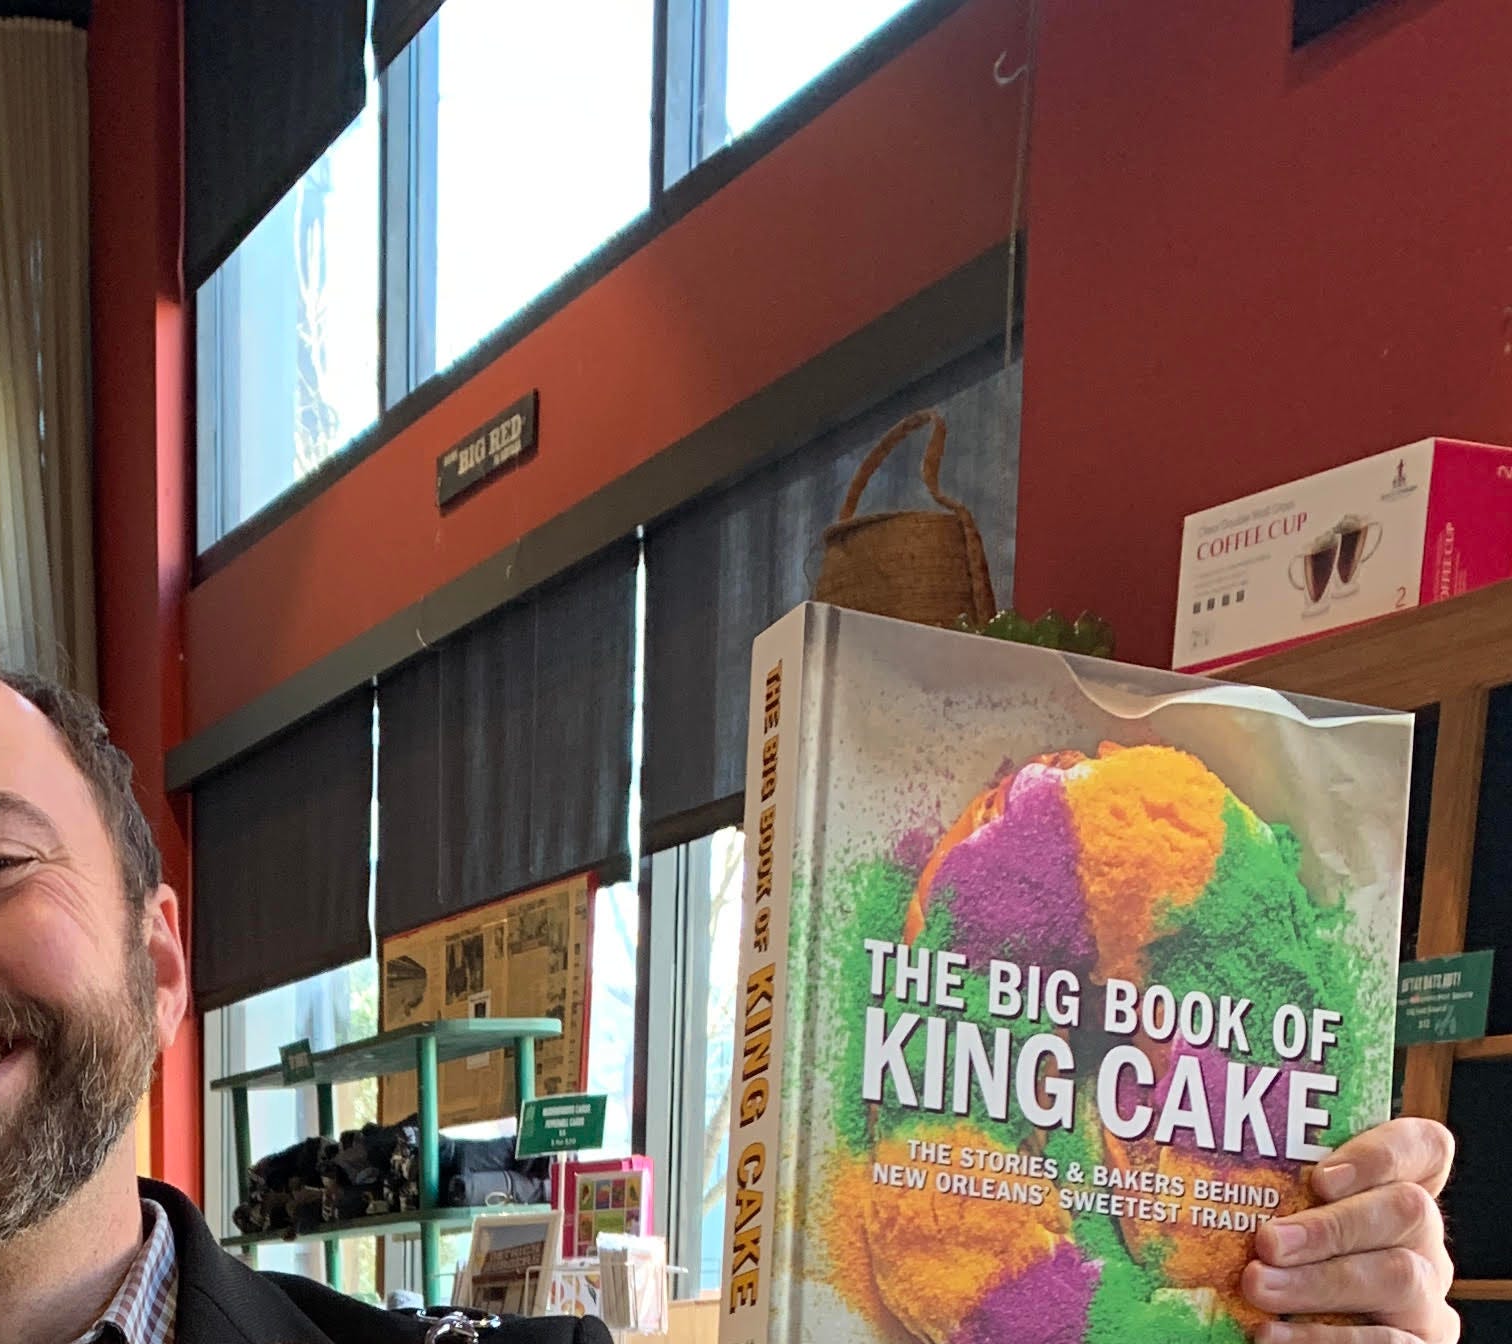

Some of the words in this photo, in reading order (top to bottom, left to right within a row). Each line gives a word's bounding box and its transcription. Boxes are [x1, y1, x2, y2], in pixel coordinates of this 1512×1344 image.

[1197, 524, 1262, 561] COFFEE
[1268, 512, 1308, 540] CUP
[1440, 559, 1452, 600] OFFEE
[764, 658, 783, 734] THE
[761, 734, 780, 803] BIG
[756, 804, 776, 904] BOOK
[754, 907, 771, 953] OF
[864, 938, 968, 1010] THE
[989, 959, 1081, 1027] BIG
[1104, 978, 1251, 1053] BOOK
[1272, 1003, 1341, 1062] OF
[740, 962, 776, 1128] KING
[862, 1006, 1075, 1130] KING
[1097, 1045, 1339, 1163] CAKE
[873, 1162, 928, 1190] NEW
[1059, 1188, 1182, 1223] SWEETEST
[1190, 1206, 1275, 1233] TRADIT
[907, 1139, 952, 1166] THE
[960, 1147, 1058, 1180] STORIES
[1066, 1161, 1085, 1184] &
[1093, 1165, 1185, 1197] BAKERS
[1194, 1179, 1280, 1208] BEHIND
[730, 1142, 766, 1314] CAKE
